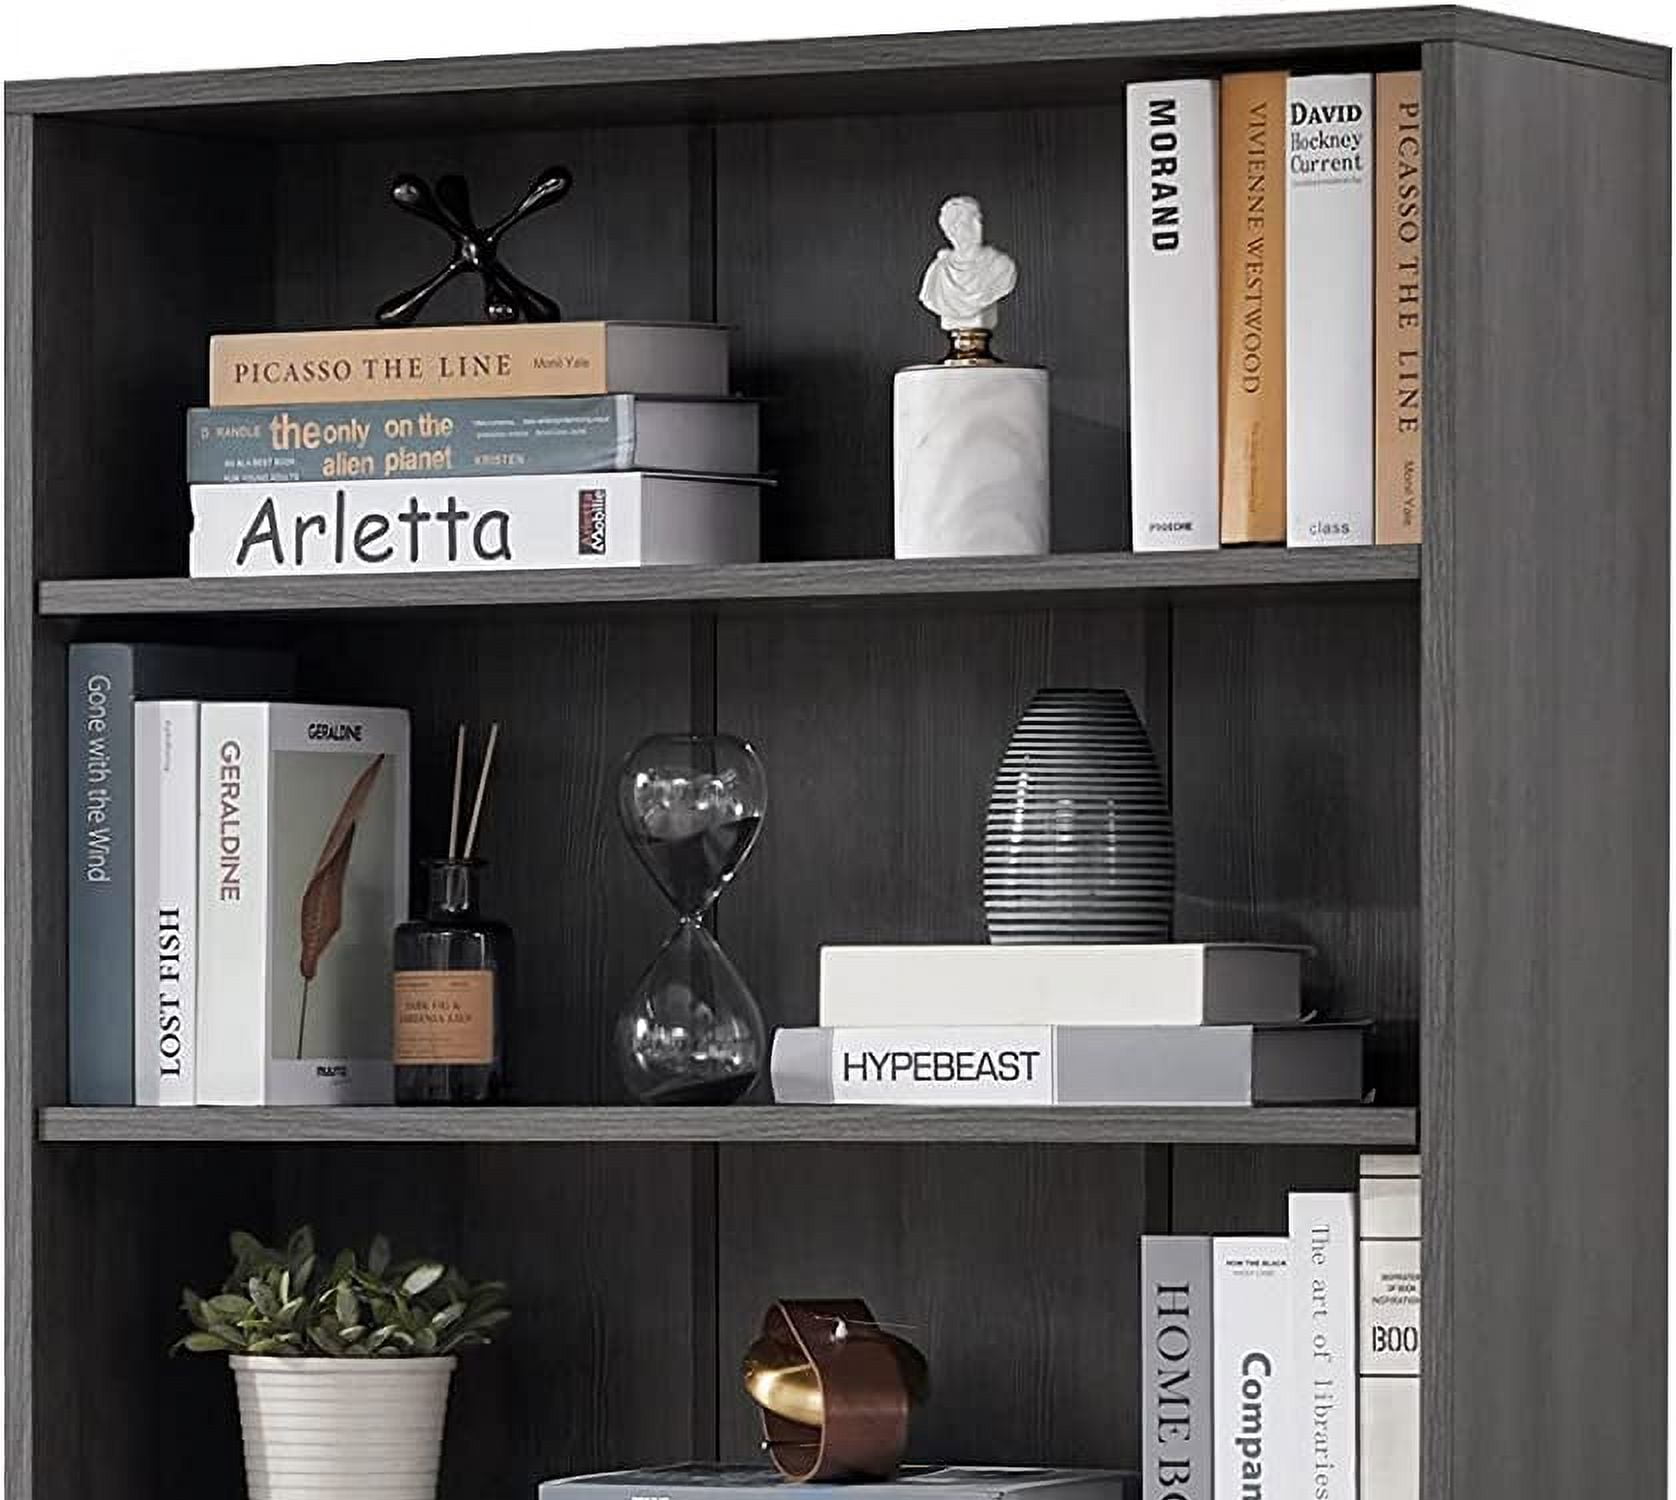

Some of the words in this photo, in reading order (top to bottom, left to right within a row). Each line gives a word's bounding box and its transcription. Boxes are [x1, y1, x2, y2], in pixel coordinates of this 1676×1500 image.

[1291, 102, 1362, 126] DAVID
[1291, 130, 1361, 151] Hockney
[1291, 155, 1362, 173] Current
[1149, 99, 1179, 251] MORAND
[1247, 101, 1267, 234] VIVIENNE
[1399, 103, 1419, 244] PICASSO
[1244, 236, 1266, 395] WESTWOOD
[1399, 256, 1419, 329] THE
[234, 359, 352, 384] PICASSO
[362, 356, 423, 379] THE
[440, 353, 512, 377] LINE
[1399, 350, 1419, 433] LINE
[271, 412, 320, 449] the
[323, 419, 369, 448] only
[384, 418, 412, 438] on
[419, 413, 453, 436] the
[322, 450, 374, 477] alien
[384, 447, 453, 476] planet
[235, 489, 512, 566] Arletta
[1309, 520, 1350, 536] class
[87, 675, 111, 729] Gone
[88, 731, 111, 782] with
[88, 785, 111, 824] the
[220, 741, 241, 902] GERALDINE
[87, 825, 111, 882] Wind
[159, 906, 180, 982] FISH
[160, 992, 181, 1077] LOST
[844, 1051, 1040, 1081] HYPEBEAST
[1311, 1226, 1329, 1266] The
[1311, 1279, 1328, 1320] art
[1156, 1285, 1191, 1443] HOME
[1312, 1333, 1334, 1362] of
